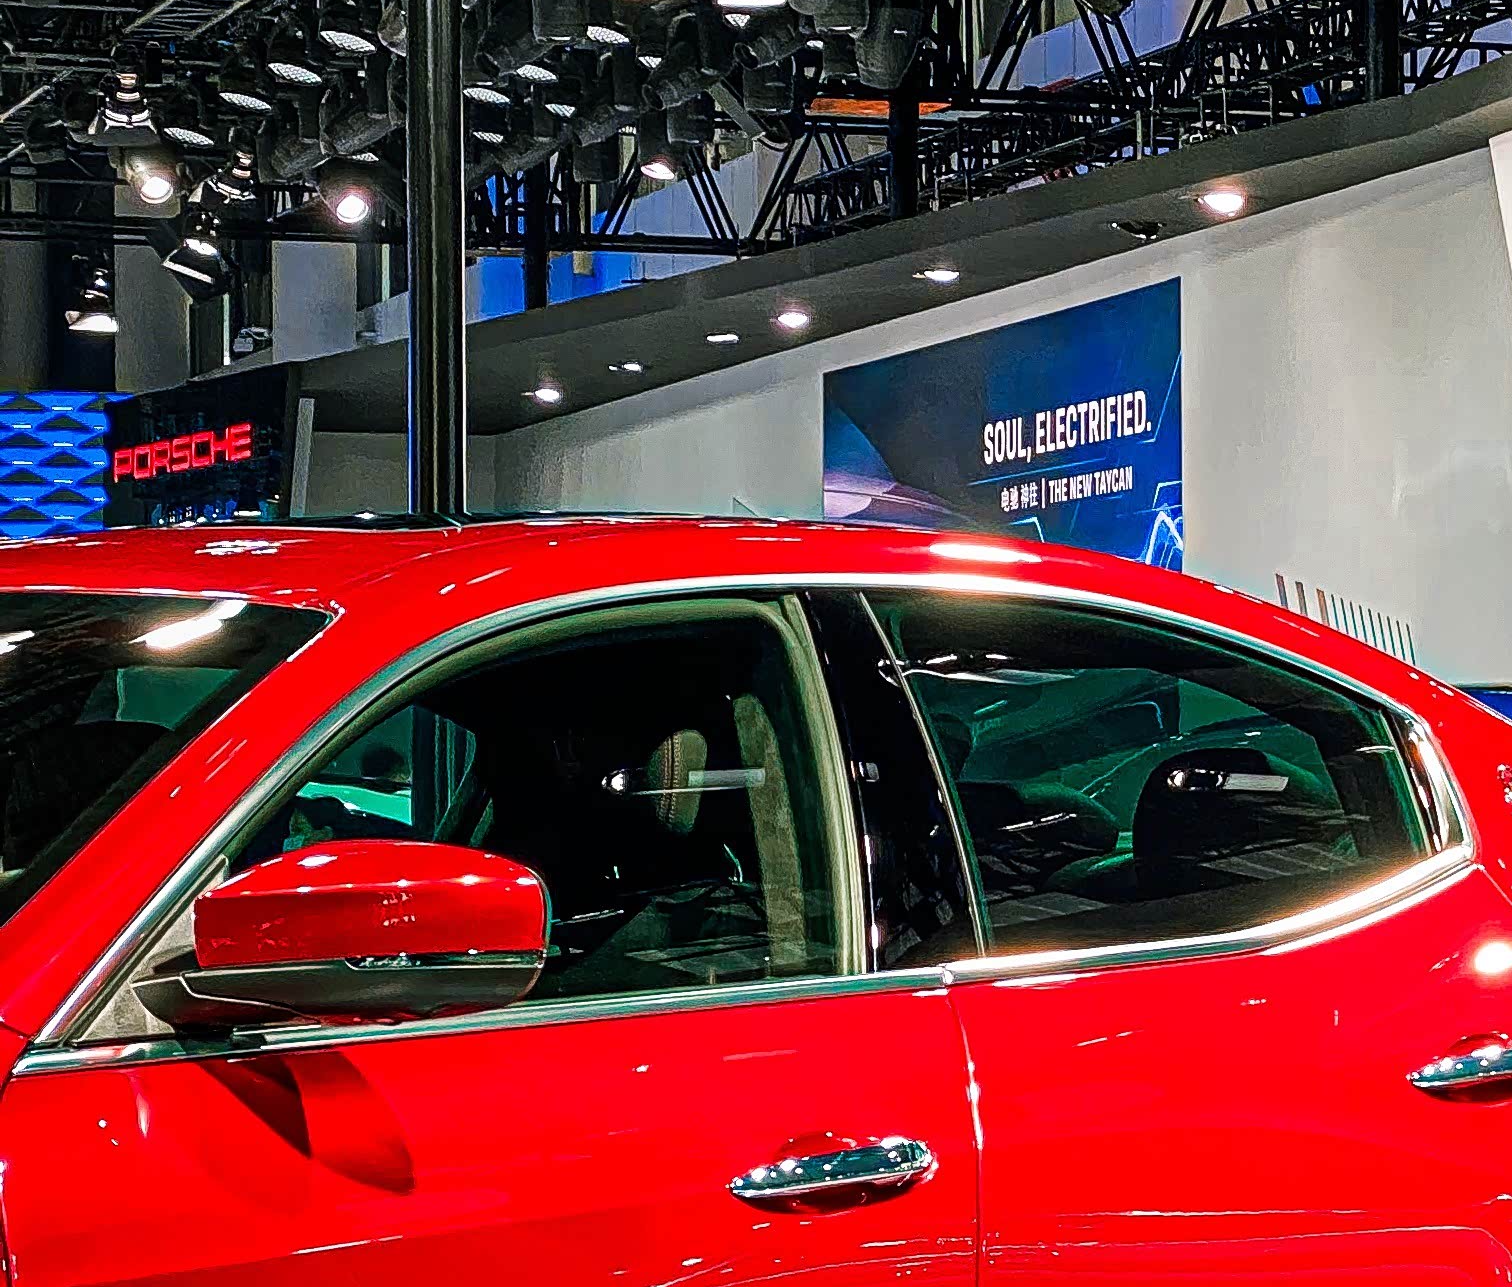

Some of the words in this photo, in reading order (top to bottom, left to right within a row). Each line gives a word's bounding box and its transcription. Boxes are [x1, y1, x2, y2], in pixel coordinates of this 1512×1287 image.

[113, 422, 251, 483] PORSCHE
[983, 417, 1032, 465] SOUL,
[1035, 390, 1152, 454] ELECTRIFIED.
[1048, 476, 1068, 504] THE
[1069, 472, 1093, 500] NEW
[1094, 465, 1133, 496] TAYCAN
